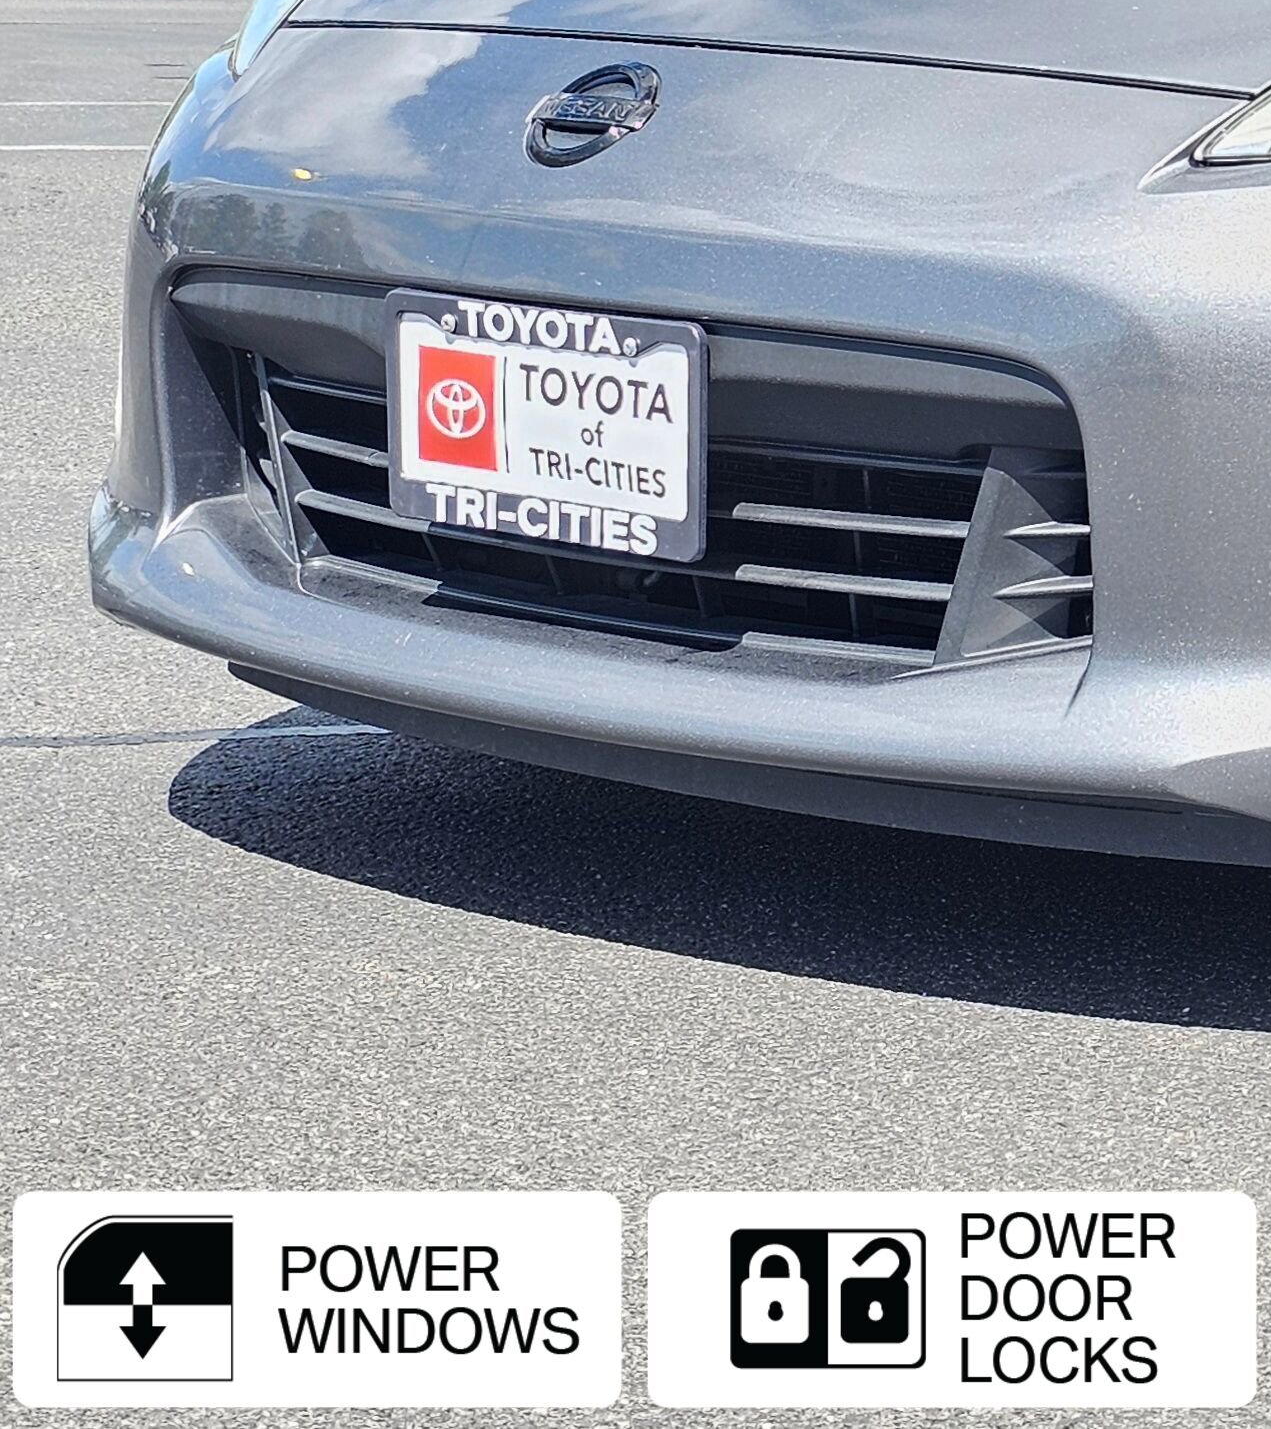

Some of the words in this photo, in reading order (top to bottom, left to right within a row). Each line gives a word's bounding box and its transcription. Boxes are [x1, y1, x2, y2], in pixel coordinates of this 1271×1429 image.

[542, 96, 637, 123] NISSAN
[457, 300, 623, 355] TOYOTA
[519, 363, 674, 424] TOYOTA
[580, 420, 604, 448] of
[528, 447, 667, 499] TRI-CITIES
[425, 482, 659, 556] TRI-CITIES
